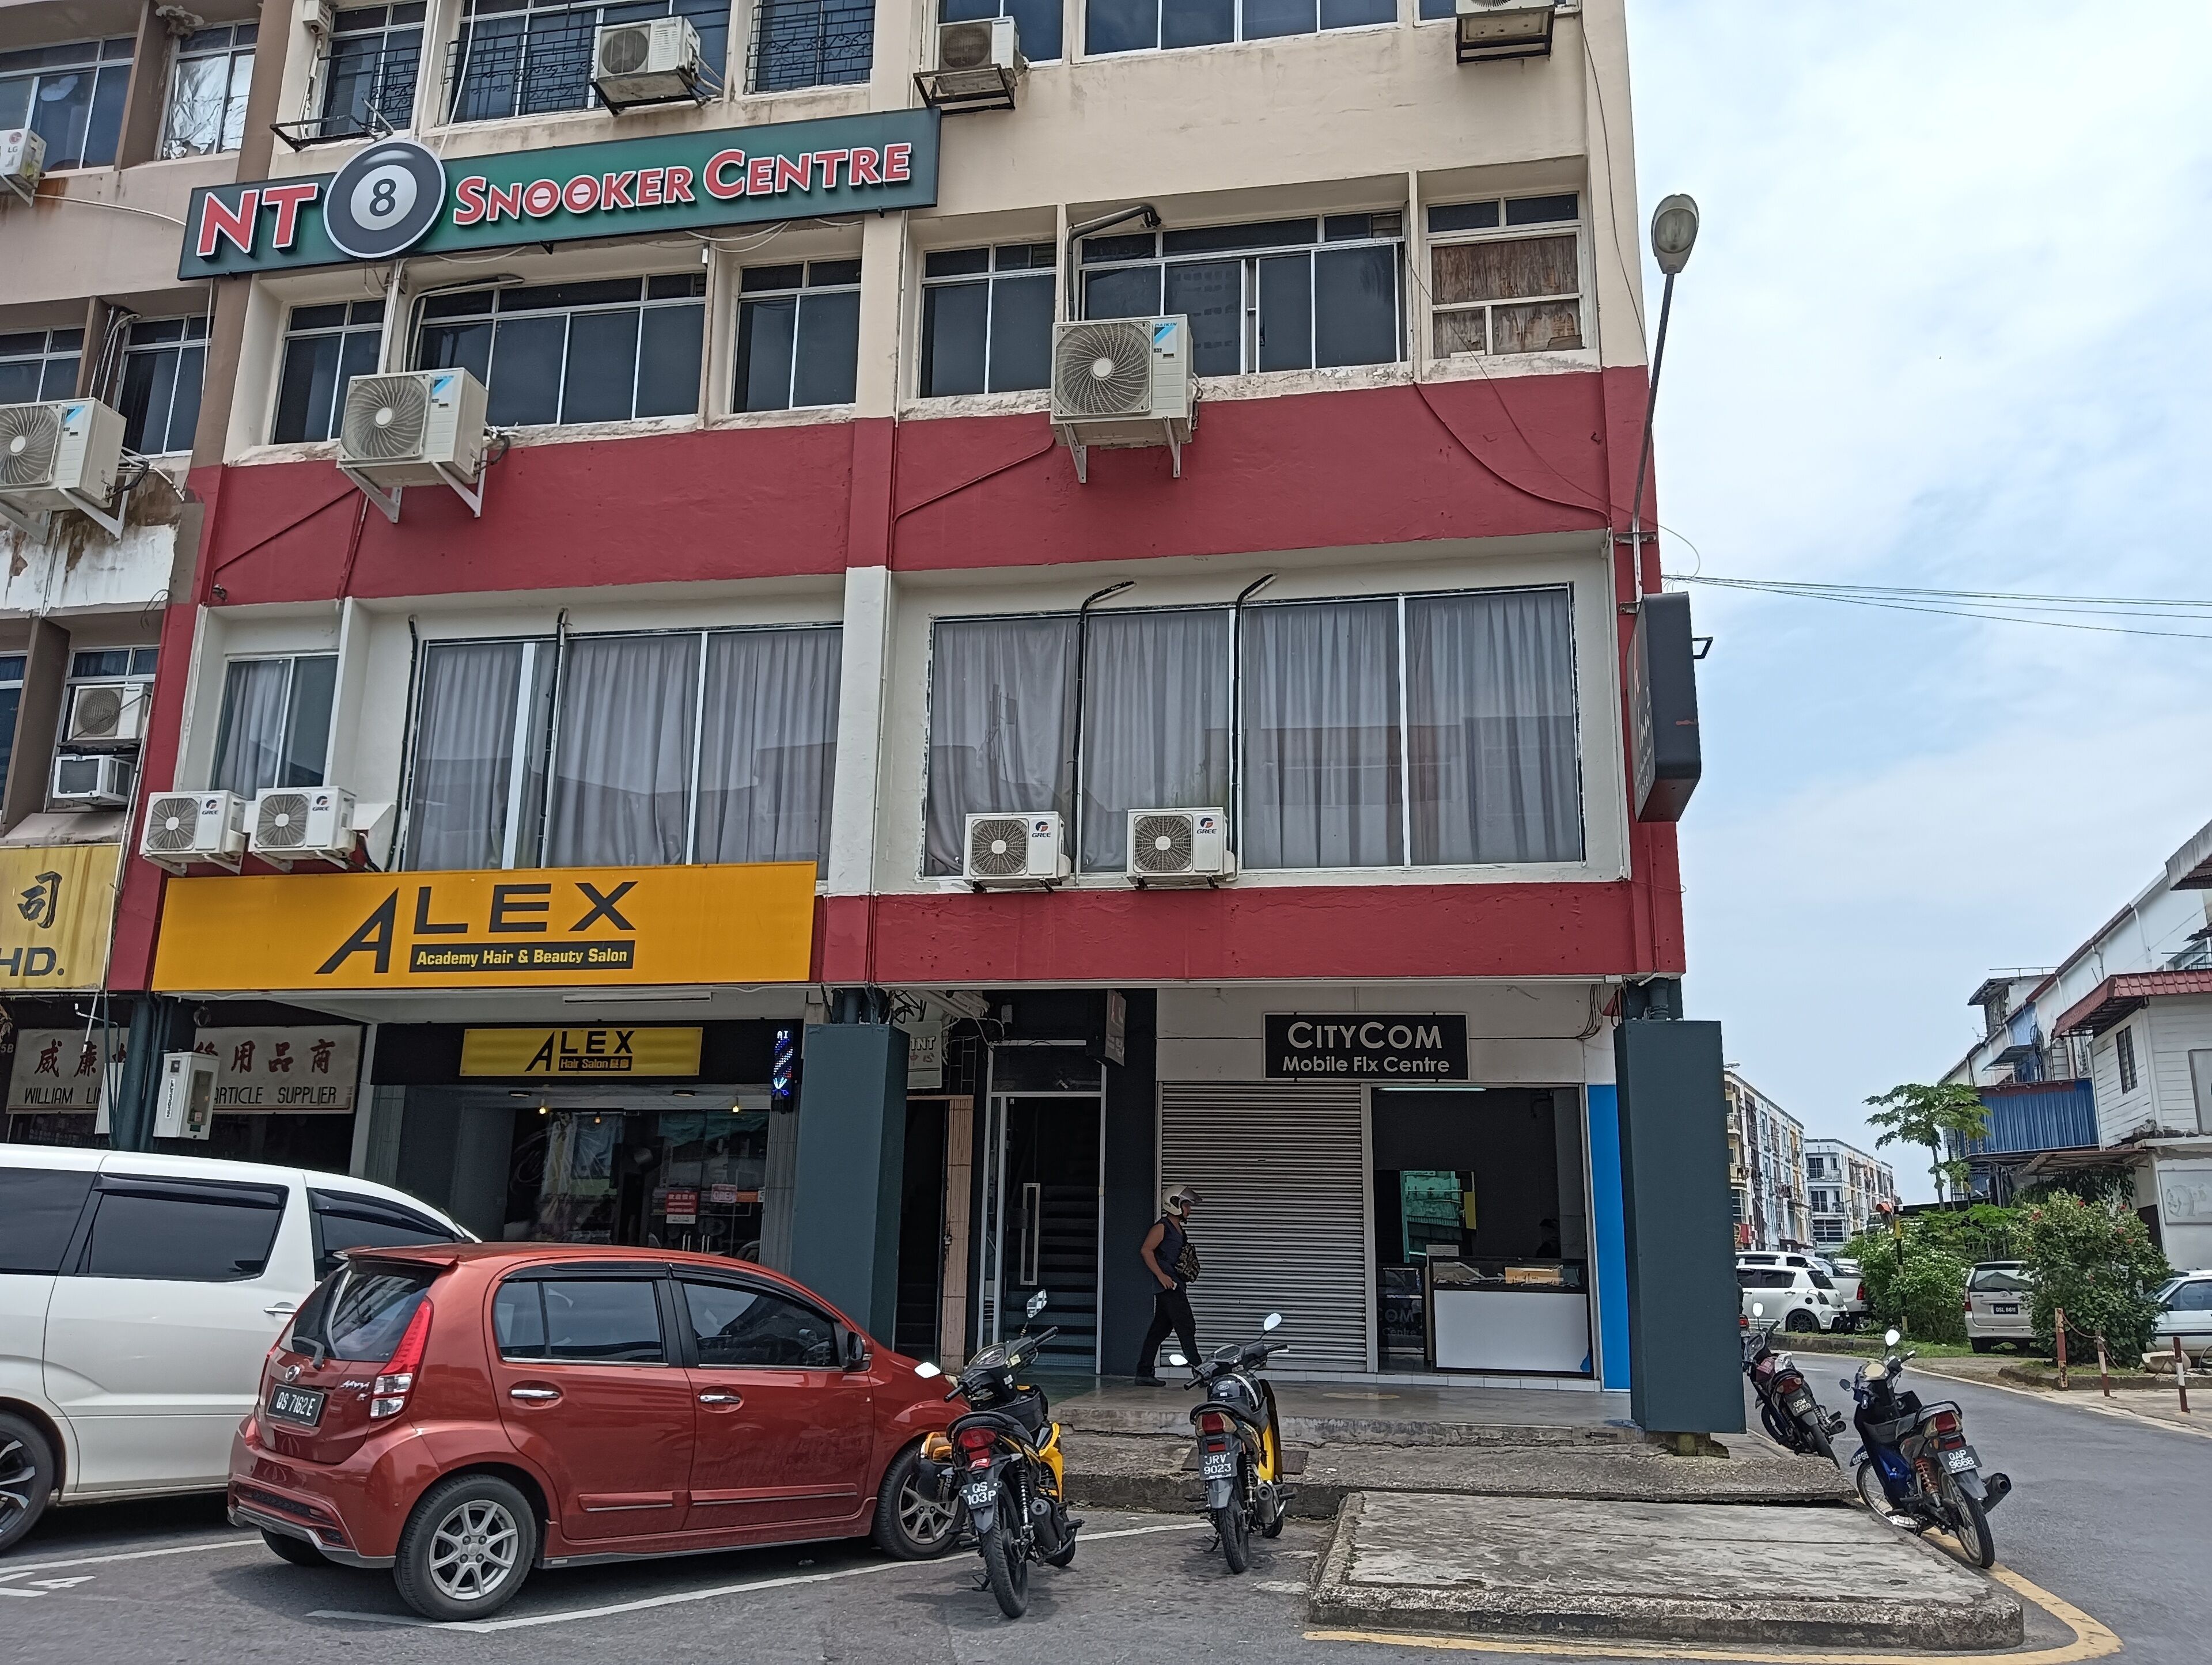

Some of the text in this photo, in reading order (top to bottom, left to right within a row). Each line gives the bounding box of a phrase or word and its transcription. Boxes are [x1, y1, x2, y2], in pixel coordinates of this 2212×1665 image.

[369, 178, 396, 217] 8
[196, 182, 319, 256] NT
[17, 870, 63, 929] 司
[314, 881, 638, 974] ALEX
[416, 947, 627, 968] Academy Hair & Beauty Salon
[524, 1030, 635, 1072] ALEX
[560, 1059, 578, 1068] Hair
[582, 1059, 608, 1068] Salon
[1283, 1056, 1348, 1072] Mobile
[1384, 1056, 1450, 1072] Centre
[24, 1087, 74, 1105] WILLIAM
[278, 1087, 337, 1105] SUPPLIER
[276, 1391, 316, 1416] QS 7162 E
[1205, 1454, 1226, 1465] JRV
[1948, 1449, 1967, 1460] QAP
[1949, 1456, 1975, 1469] 9668
[1203, 1463, 1232, 1475] 9023
[972, 1481, 988, 1493] QS
[967, 1490, 997, 1505] 103P
